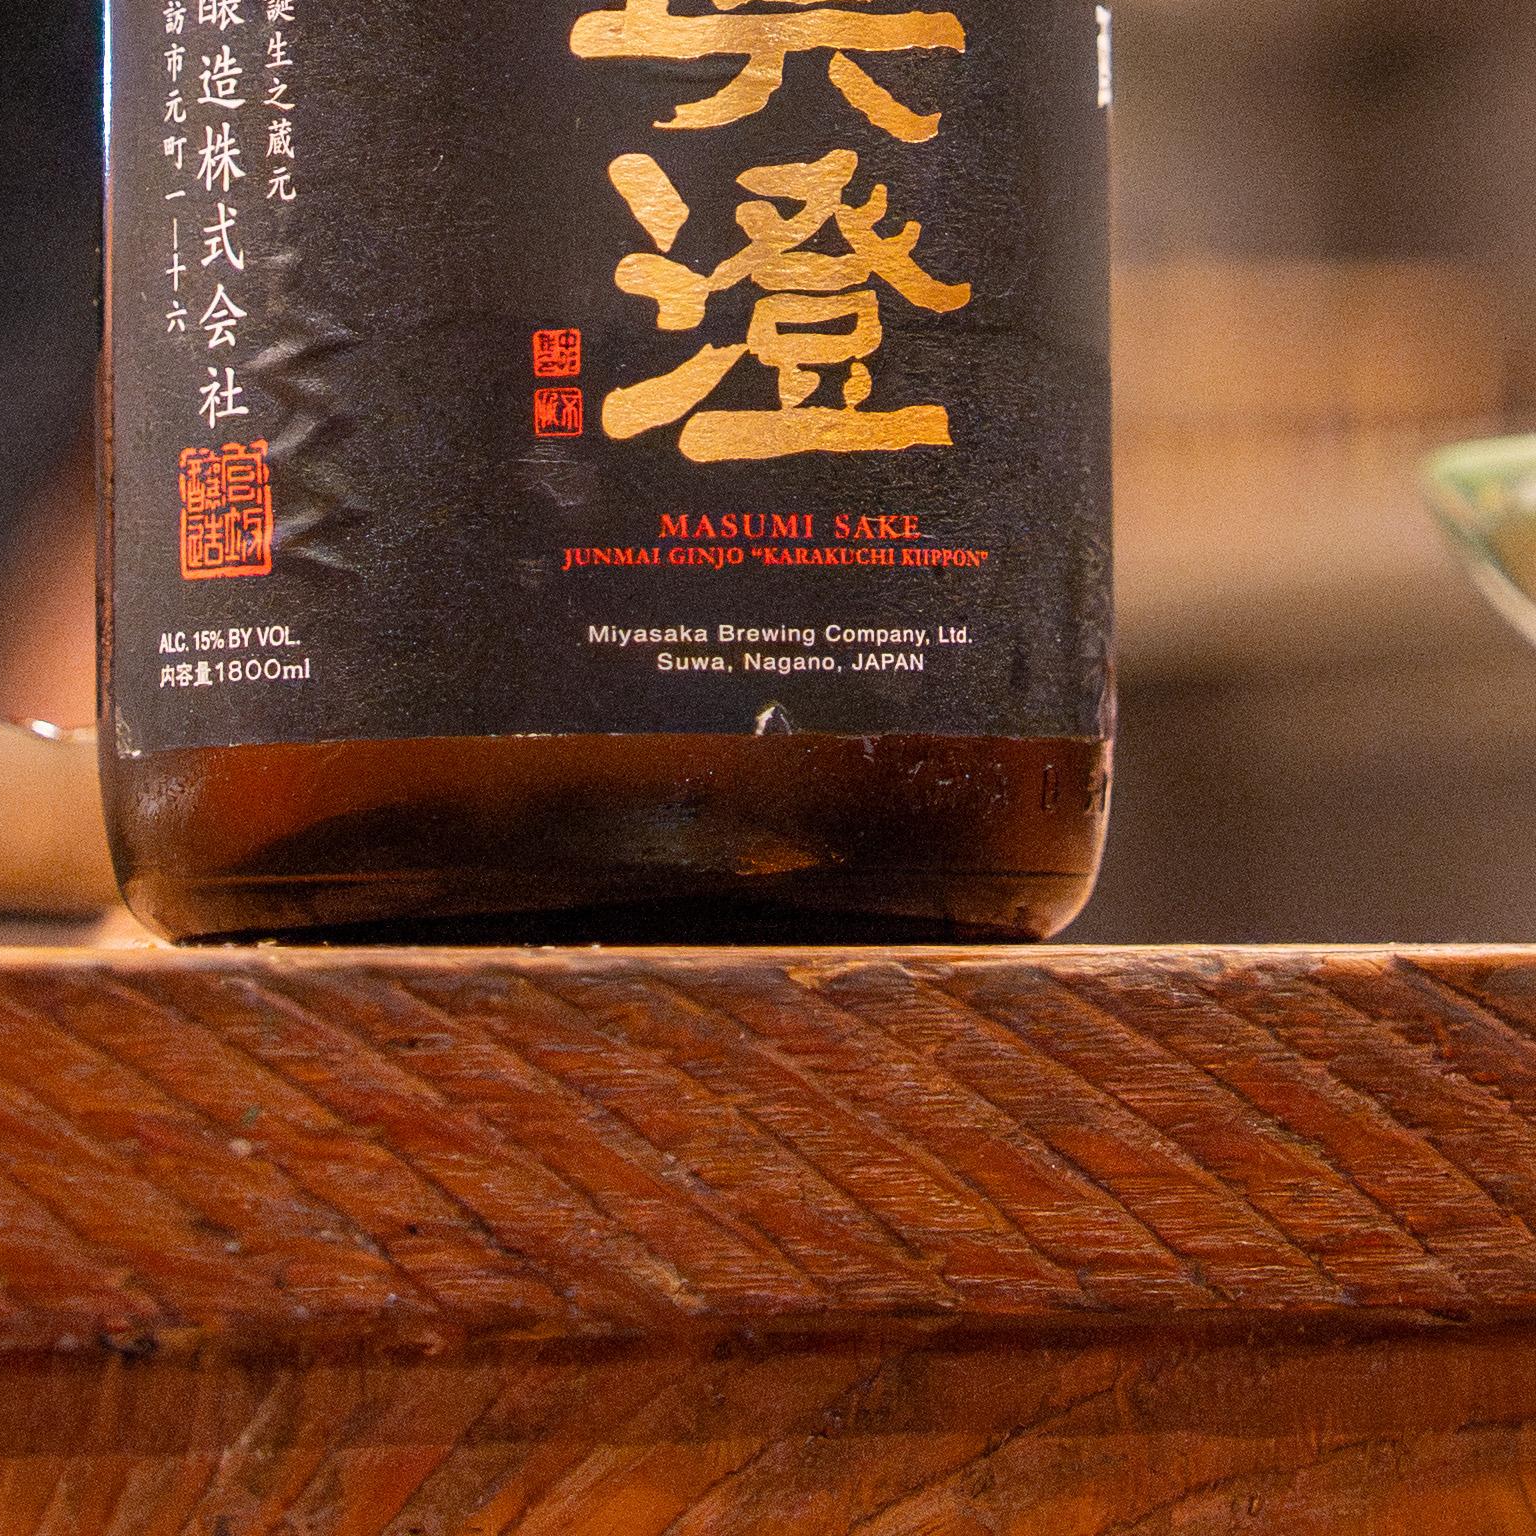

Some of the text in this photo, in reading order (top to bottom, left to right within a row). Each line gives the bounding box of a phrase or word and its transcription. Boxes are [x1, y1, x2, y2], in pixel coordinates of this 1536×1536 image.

[658, 513, 922, 540] MASUMI SAKE
[560, 547, 662, 571] JUNMAI
[668, 547, 744, 571] GINJO
[159, 625, 301, 654] ALC. 15% BY VOL.
[588, 624, 973, 648] Miyasaka Brewing Company, Ltd.
[656, 652, 925, 674] Suwa, Nagano, JAPAN
